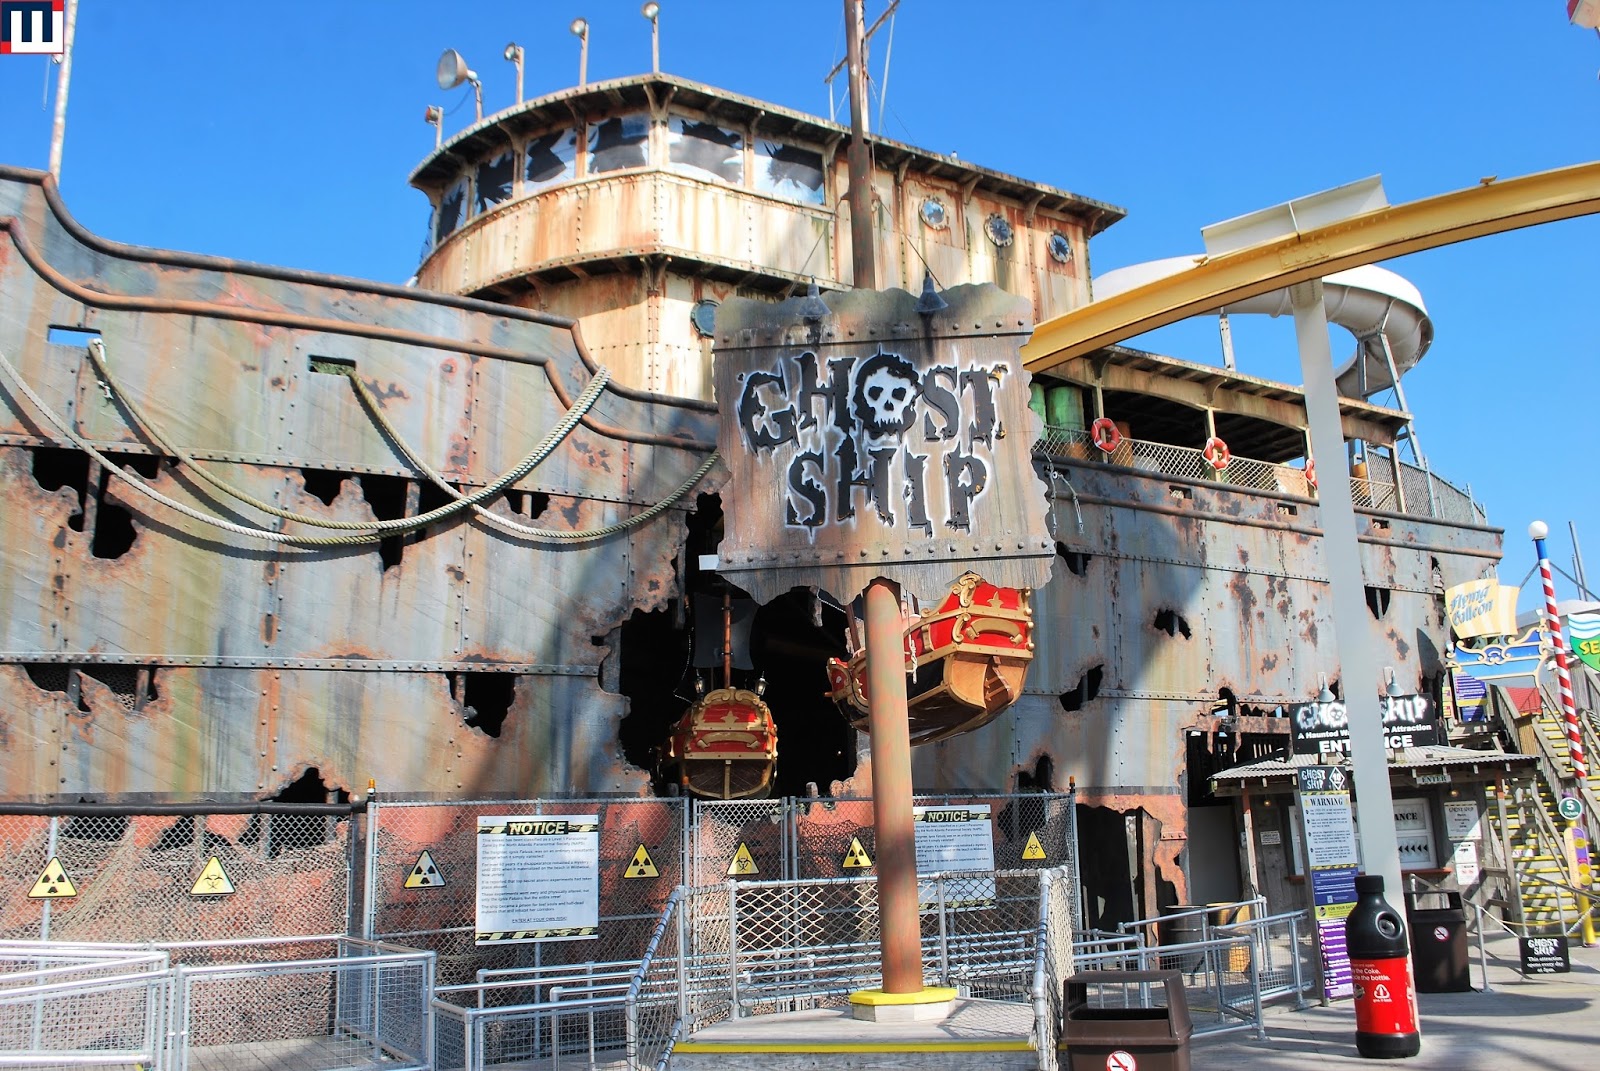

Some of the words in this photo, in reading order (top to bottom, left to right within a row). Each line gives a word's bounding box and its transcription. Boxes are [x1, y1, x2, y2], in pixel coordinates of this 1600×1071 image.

[736, 344, 1010, 456] GHOST
[785, 438, 990, 544] SHIP
[1392, 724, 1432, 733] Attraction
[1302, 768, 1326, 780] GHOST
[1307, 780, 1324, 790] SHIP
[1310, 798, 1342, 806] WARNING
[1566, 800, 1575, 810] 5
[928, 811, 968, 822] NOTICE
[1394, 812, 1418, 820] ANCE
[509, 822, 566, 834] NOTICE
[1528, 938, 1558, 948] GHOST
[1534, 946, 1555, 955] SHIP
